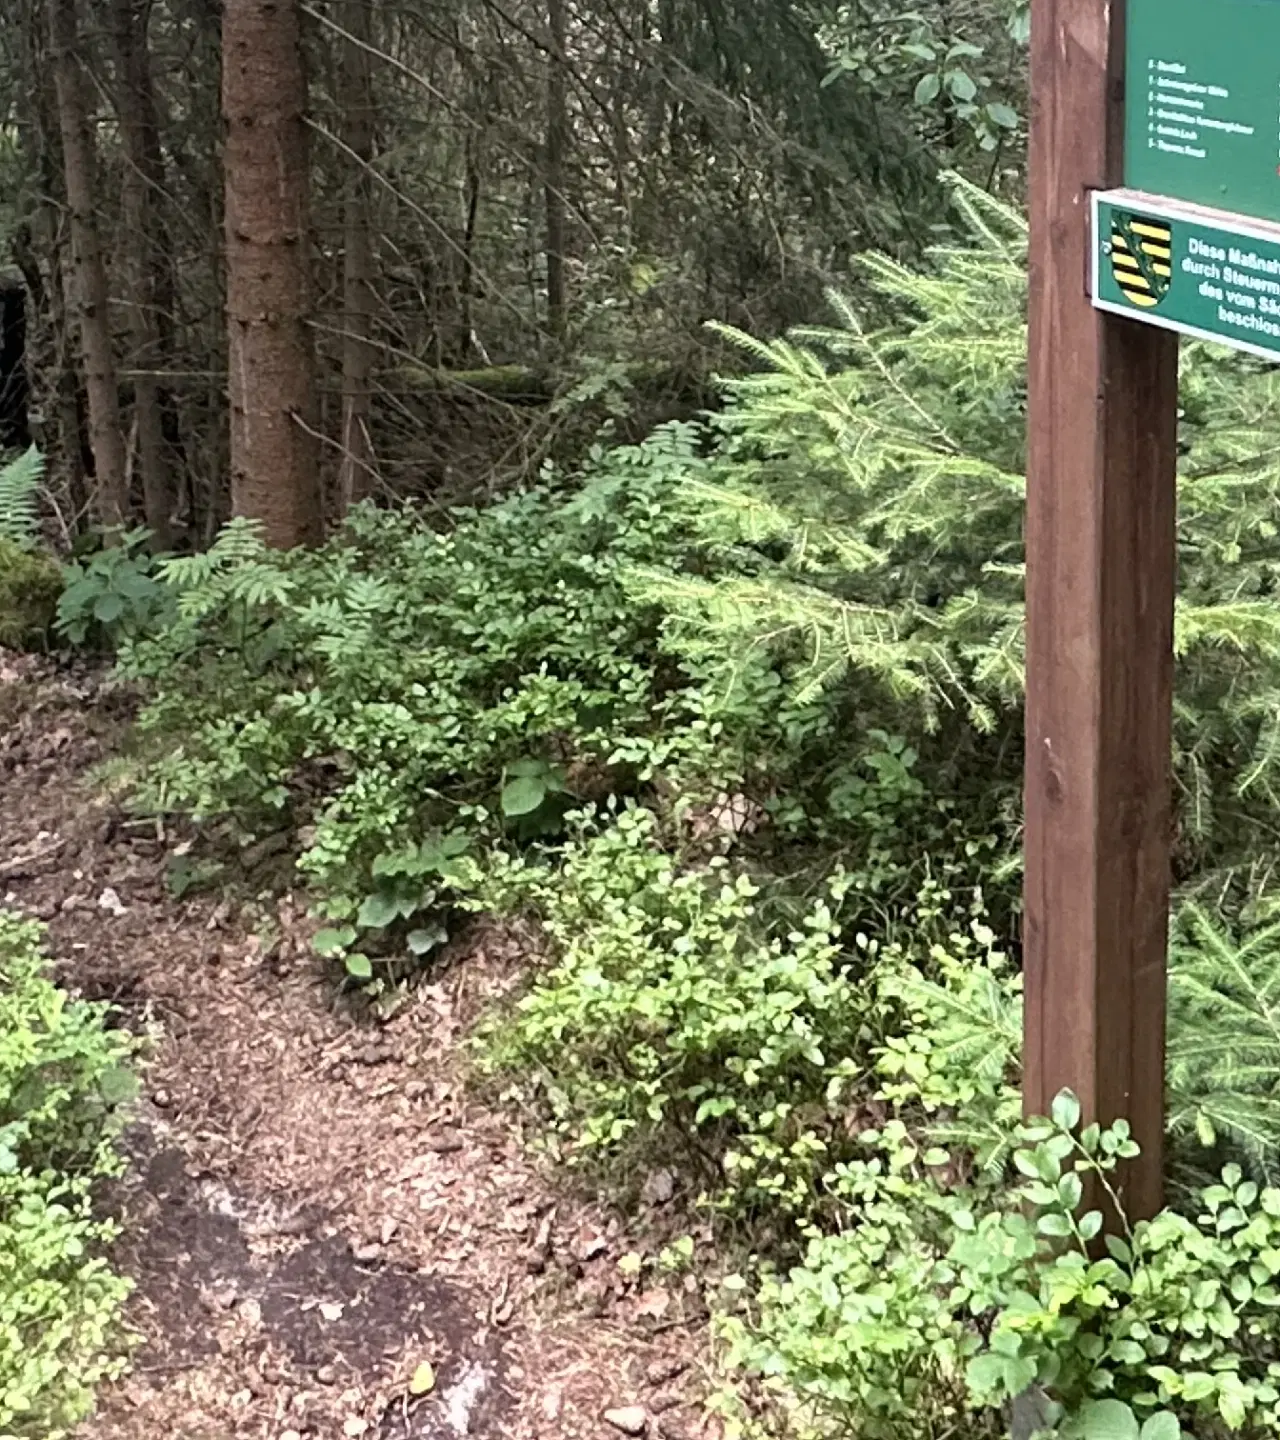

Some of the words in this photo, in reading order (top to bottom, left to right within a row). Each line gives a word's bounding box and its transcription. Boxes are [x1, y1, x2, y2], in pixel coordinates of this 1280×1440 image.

[1189, 238, 1225, 262] Diese
[1180, 256, 1220, 279] durch
[1198, 280, 1223, 300] des
[1225, 289, 1256, 309] vom
